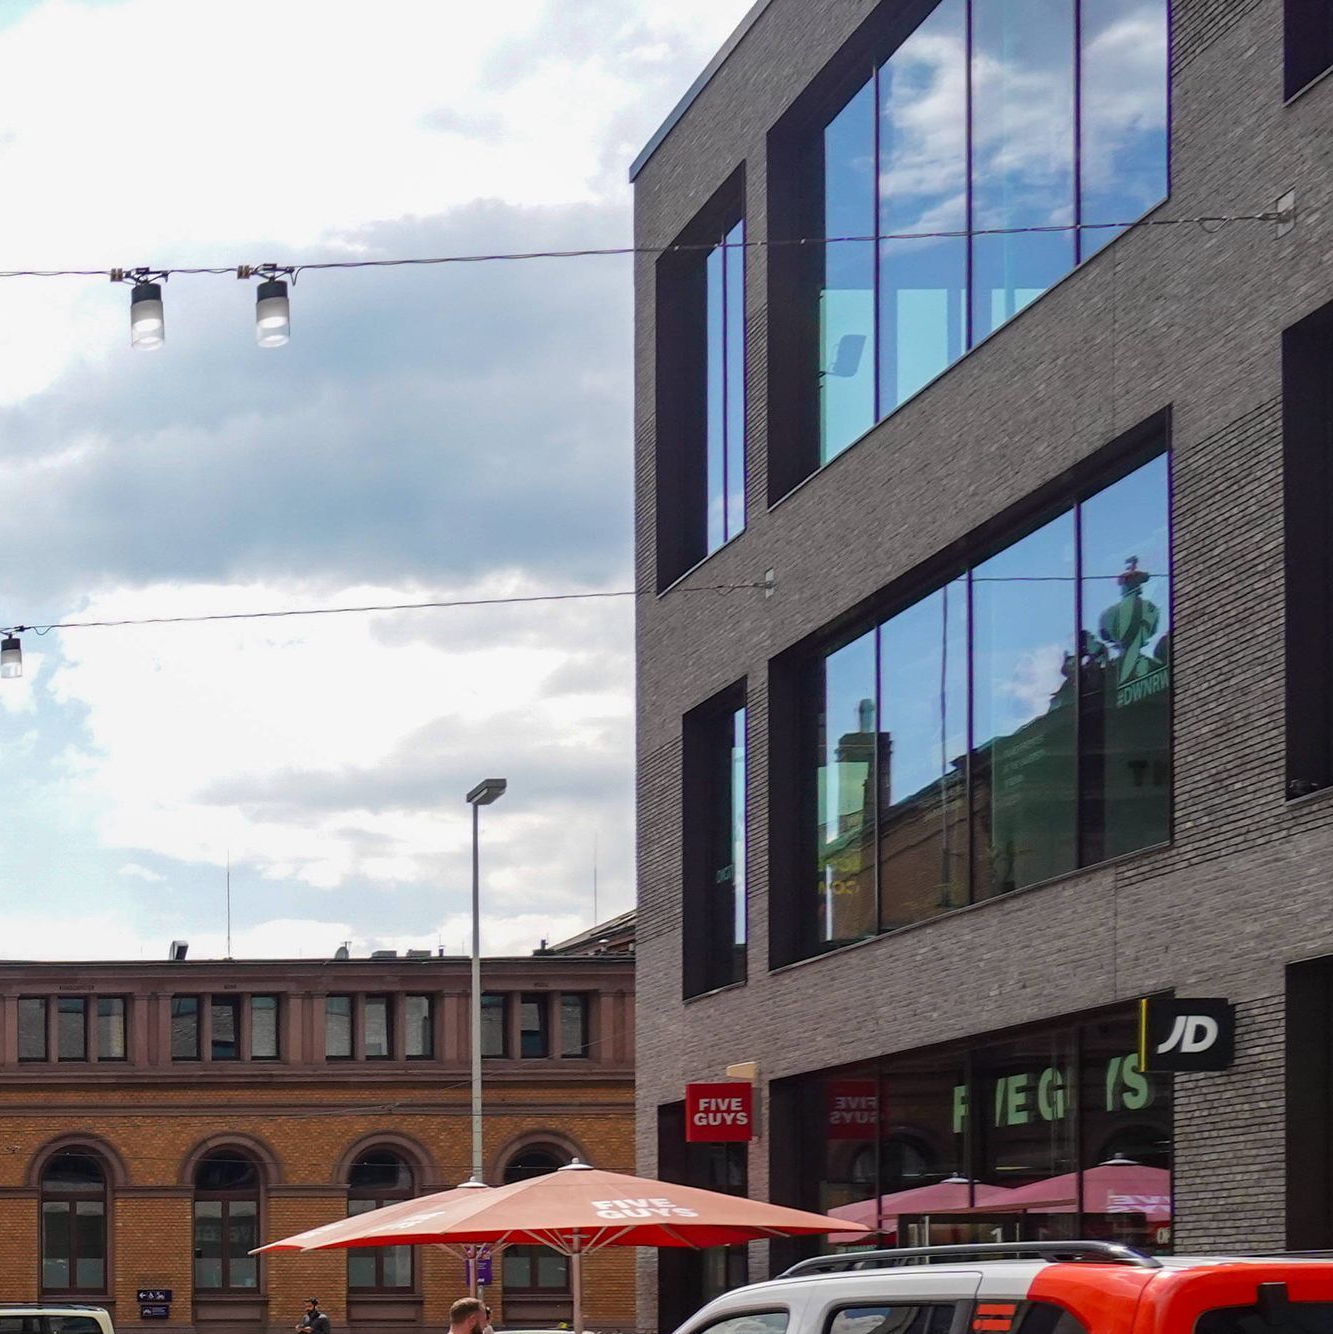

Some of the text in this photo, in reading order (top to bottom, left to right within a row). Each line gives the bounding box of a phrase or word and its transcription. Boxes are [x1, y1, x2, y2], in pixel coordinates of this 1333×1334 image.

[1157, 1015, 1219, 1054] JD
[699, 1098, 743, 1111] FIVE
[693, 1112, 749, 1126] GUYS
[591, 1198, 677, 1210] FIVE
[596, 1208, 699, 1219] GUYS
